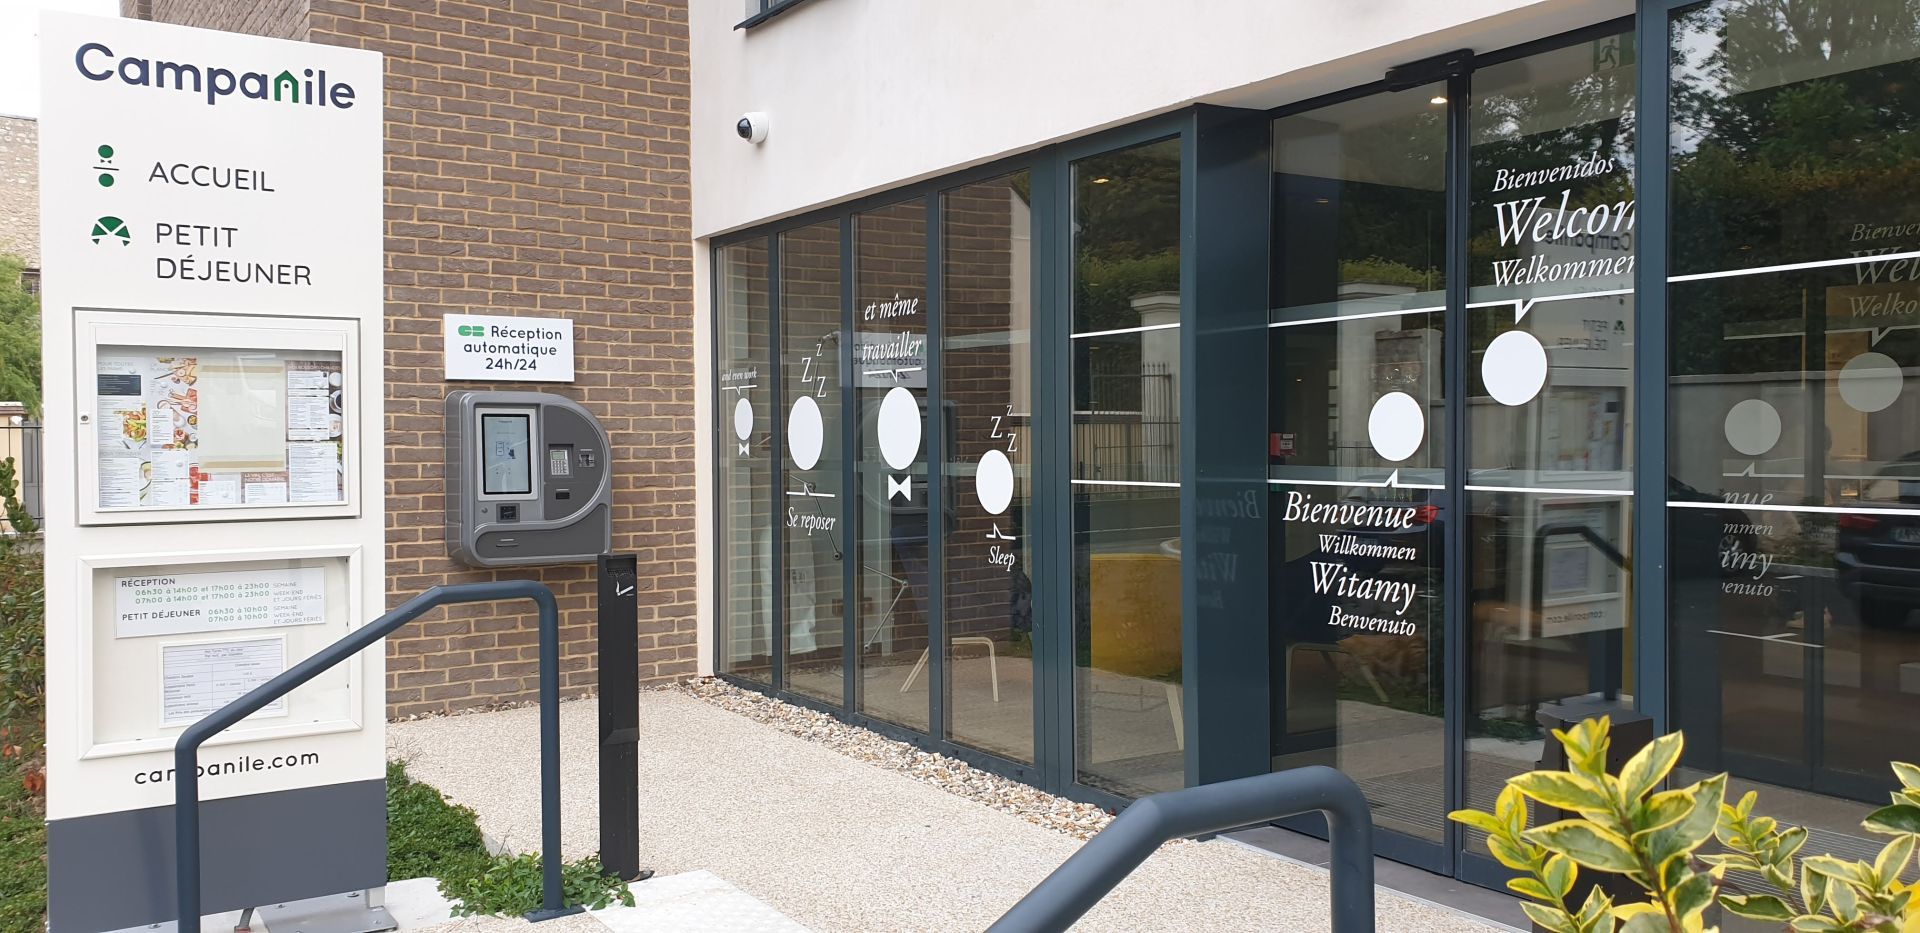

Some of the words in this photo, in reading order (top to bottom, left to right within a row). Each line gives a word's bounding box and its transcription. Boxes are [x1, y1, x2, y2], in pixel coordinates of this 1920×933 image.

[75, 42, 356, 109] Campanile
[149, 161, 275, 192] ACCUEIL
[1492, 151, 1616, 193] Bienvenidos
[155, 222, 238, 248] PETIT
[156, 254, 312, 286] DÉJEUNER
[864, 302, 876, 321] et
[879, 292, 919, 317] même
[491, 325, 563, 341] Réception
[862, 330, 922, 361] travailler
[463, 341, 557, 356] automatique
[485, 357, 538, 371] 24h/24
[787, 506, 799, 528] Se
[800, 514, 836, 536] reposer
[1283, 491, 1416, 529] Bienvenue
[988, 546, 1015, 571] Sleep
[1319, 533, 1416, 561] Willkommen
[121, 578, 176, 587] RÉCEPTION
[135, 588, 163, 596] 06h30
[173, 586, 198, 594] 14h00
[245, 582, 270, 590] 23h00
[1310, 561, 1416, 616] Witamy
[135, 597, 163, 605] 07h00
[173, 594, 198, 602] 14h00
[211, 592, 235, 600] 17h00
[245, 590, 270, 598] 23h00
[208, 607, 234, 615] 06h30
[122, 612, 148, 621] PETIT
[151, 609, 201, 619] DÉJEUNER
[208, 615, 234, 623] 07h00
[1328, 605, 1416, 636] Benvenuto
